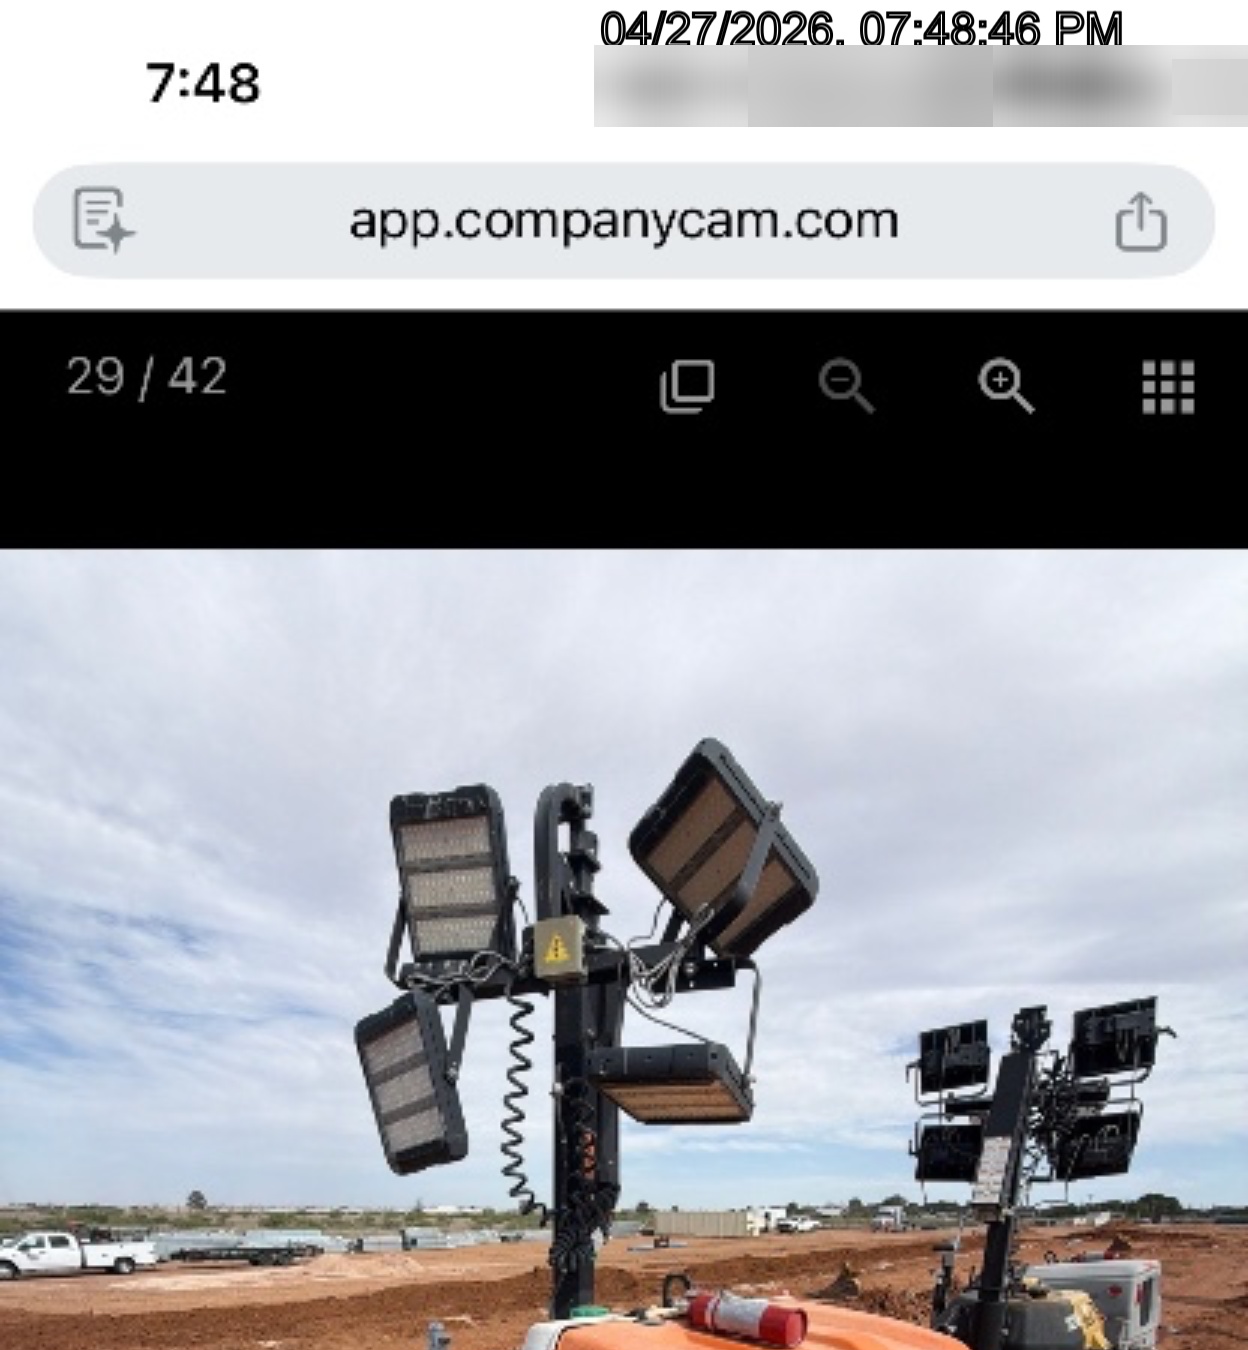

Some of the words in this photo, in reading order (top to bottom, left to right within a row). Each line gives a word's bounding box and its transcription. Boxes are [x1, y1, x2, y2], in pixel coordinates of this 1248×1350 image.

[146, 62, 260, 104] 7:48
[350, 201, 898, 250] app.companycam.com
[66, 355, 124, 396] 29
[138, 355, 154, 403] /
[168, 355, 227, 396] 42
